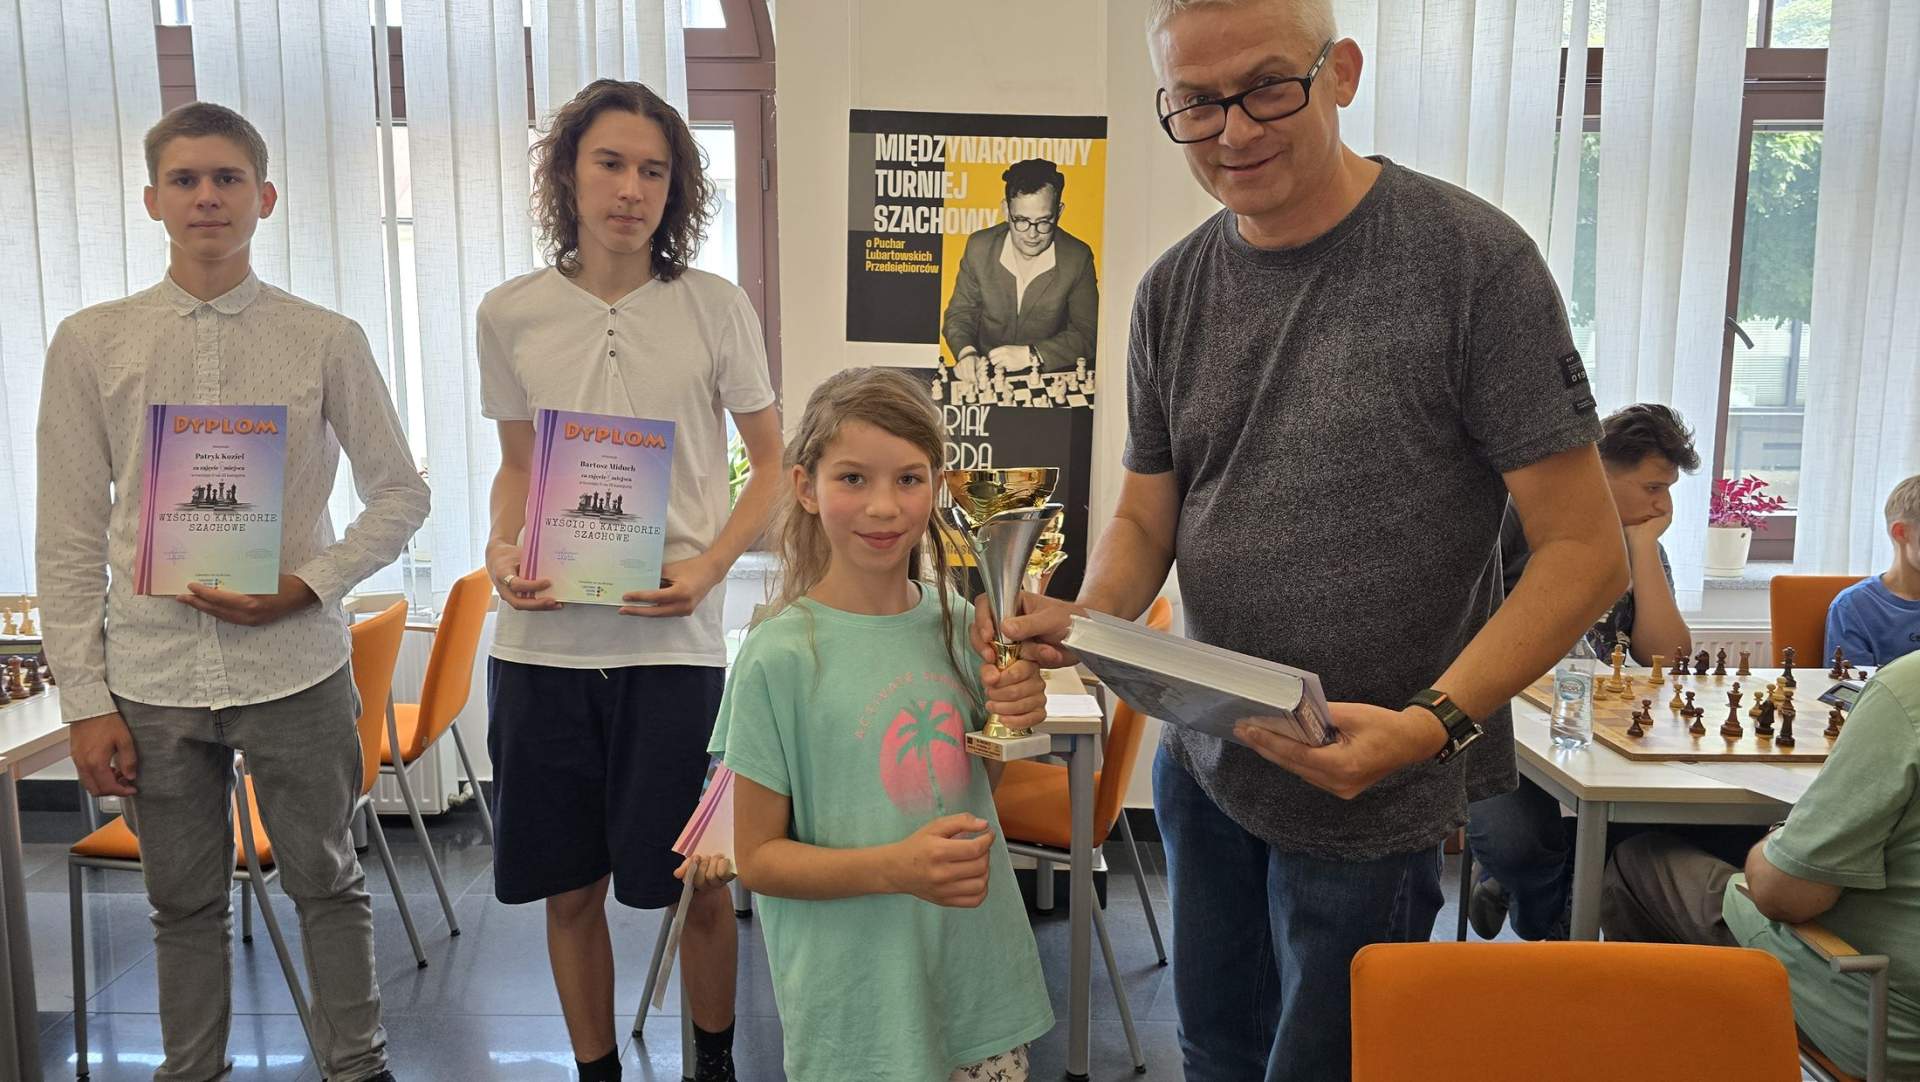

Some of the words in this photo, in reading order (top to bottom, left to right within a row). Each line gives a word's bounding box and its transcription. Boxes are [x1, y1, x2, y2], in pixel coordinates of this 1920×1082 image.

[875, 133, 1092, 166] MIĘDZYNARODOWY
[875, 169, 968, 199] TURNIEJ
[874, 205, 999, 235] SZACHOWY
[866, 241, 872, 249] o
[873, 238, 906, 250] Puchar
[865, 249, 933, 263] Lubartowskich
[865, 262, 940, 275] Przedsiębiorców
[174, 416, 278, 434] DYPLOM
[938, 405, 991, 437] RIAŁ
[564, 421, 667, 449] DYPLOM
[195, 453, 220, 462] Patryk
[943, 442, 993, 470] RDA
[580, 461, 608, 470] Bartosz
[203, 513, 212, 522] O
[213, 512, 278, 522] KATEGORIE
[188, 523, 247, 532] SZACHOWE
[589, 521, 596, 529] O
[600, 521, 661, 535] KATEGORIE
[574, 530, 630, 543] SZACHOWE
